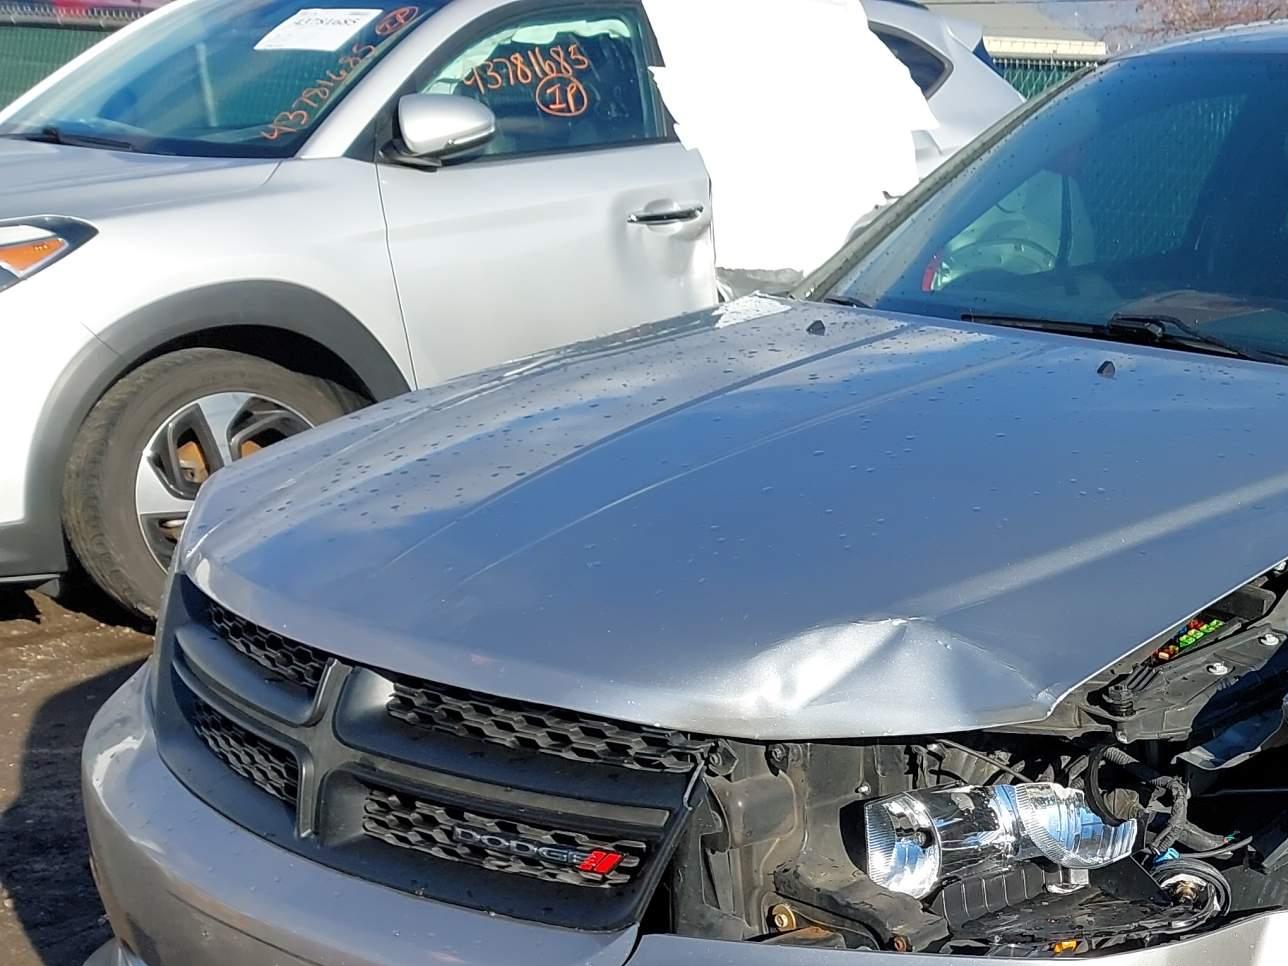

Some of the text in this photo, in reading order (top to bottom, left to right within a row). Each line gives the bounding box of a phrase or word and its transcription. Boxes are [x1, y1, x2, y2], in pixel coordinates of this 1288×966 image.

[260, 44, 376, 139] 43781685
[463, 44, 588, 94] 43781685
[452, 825, 593, 864] DODGE
